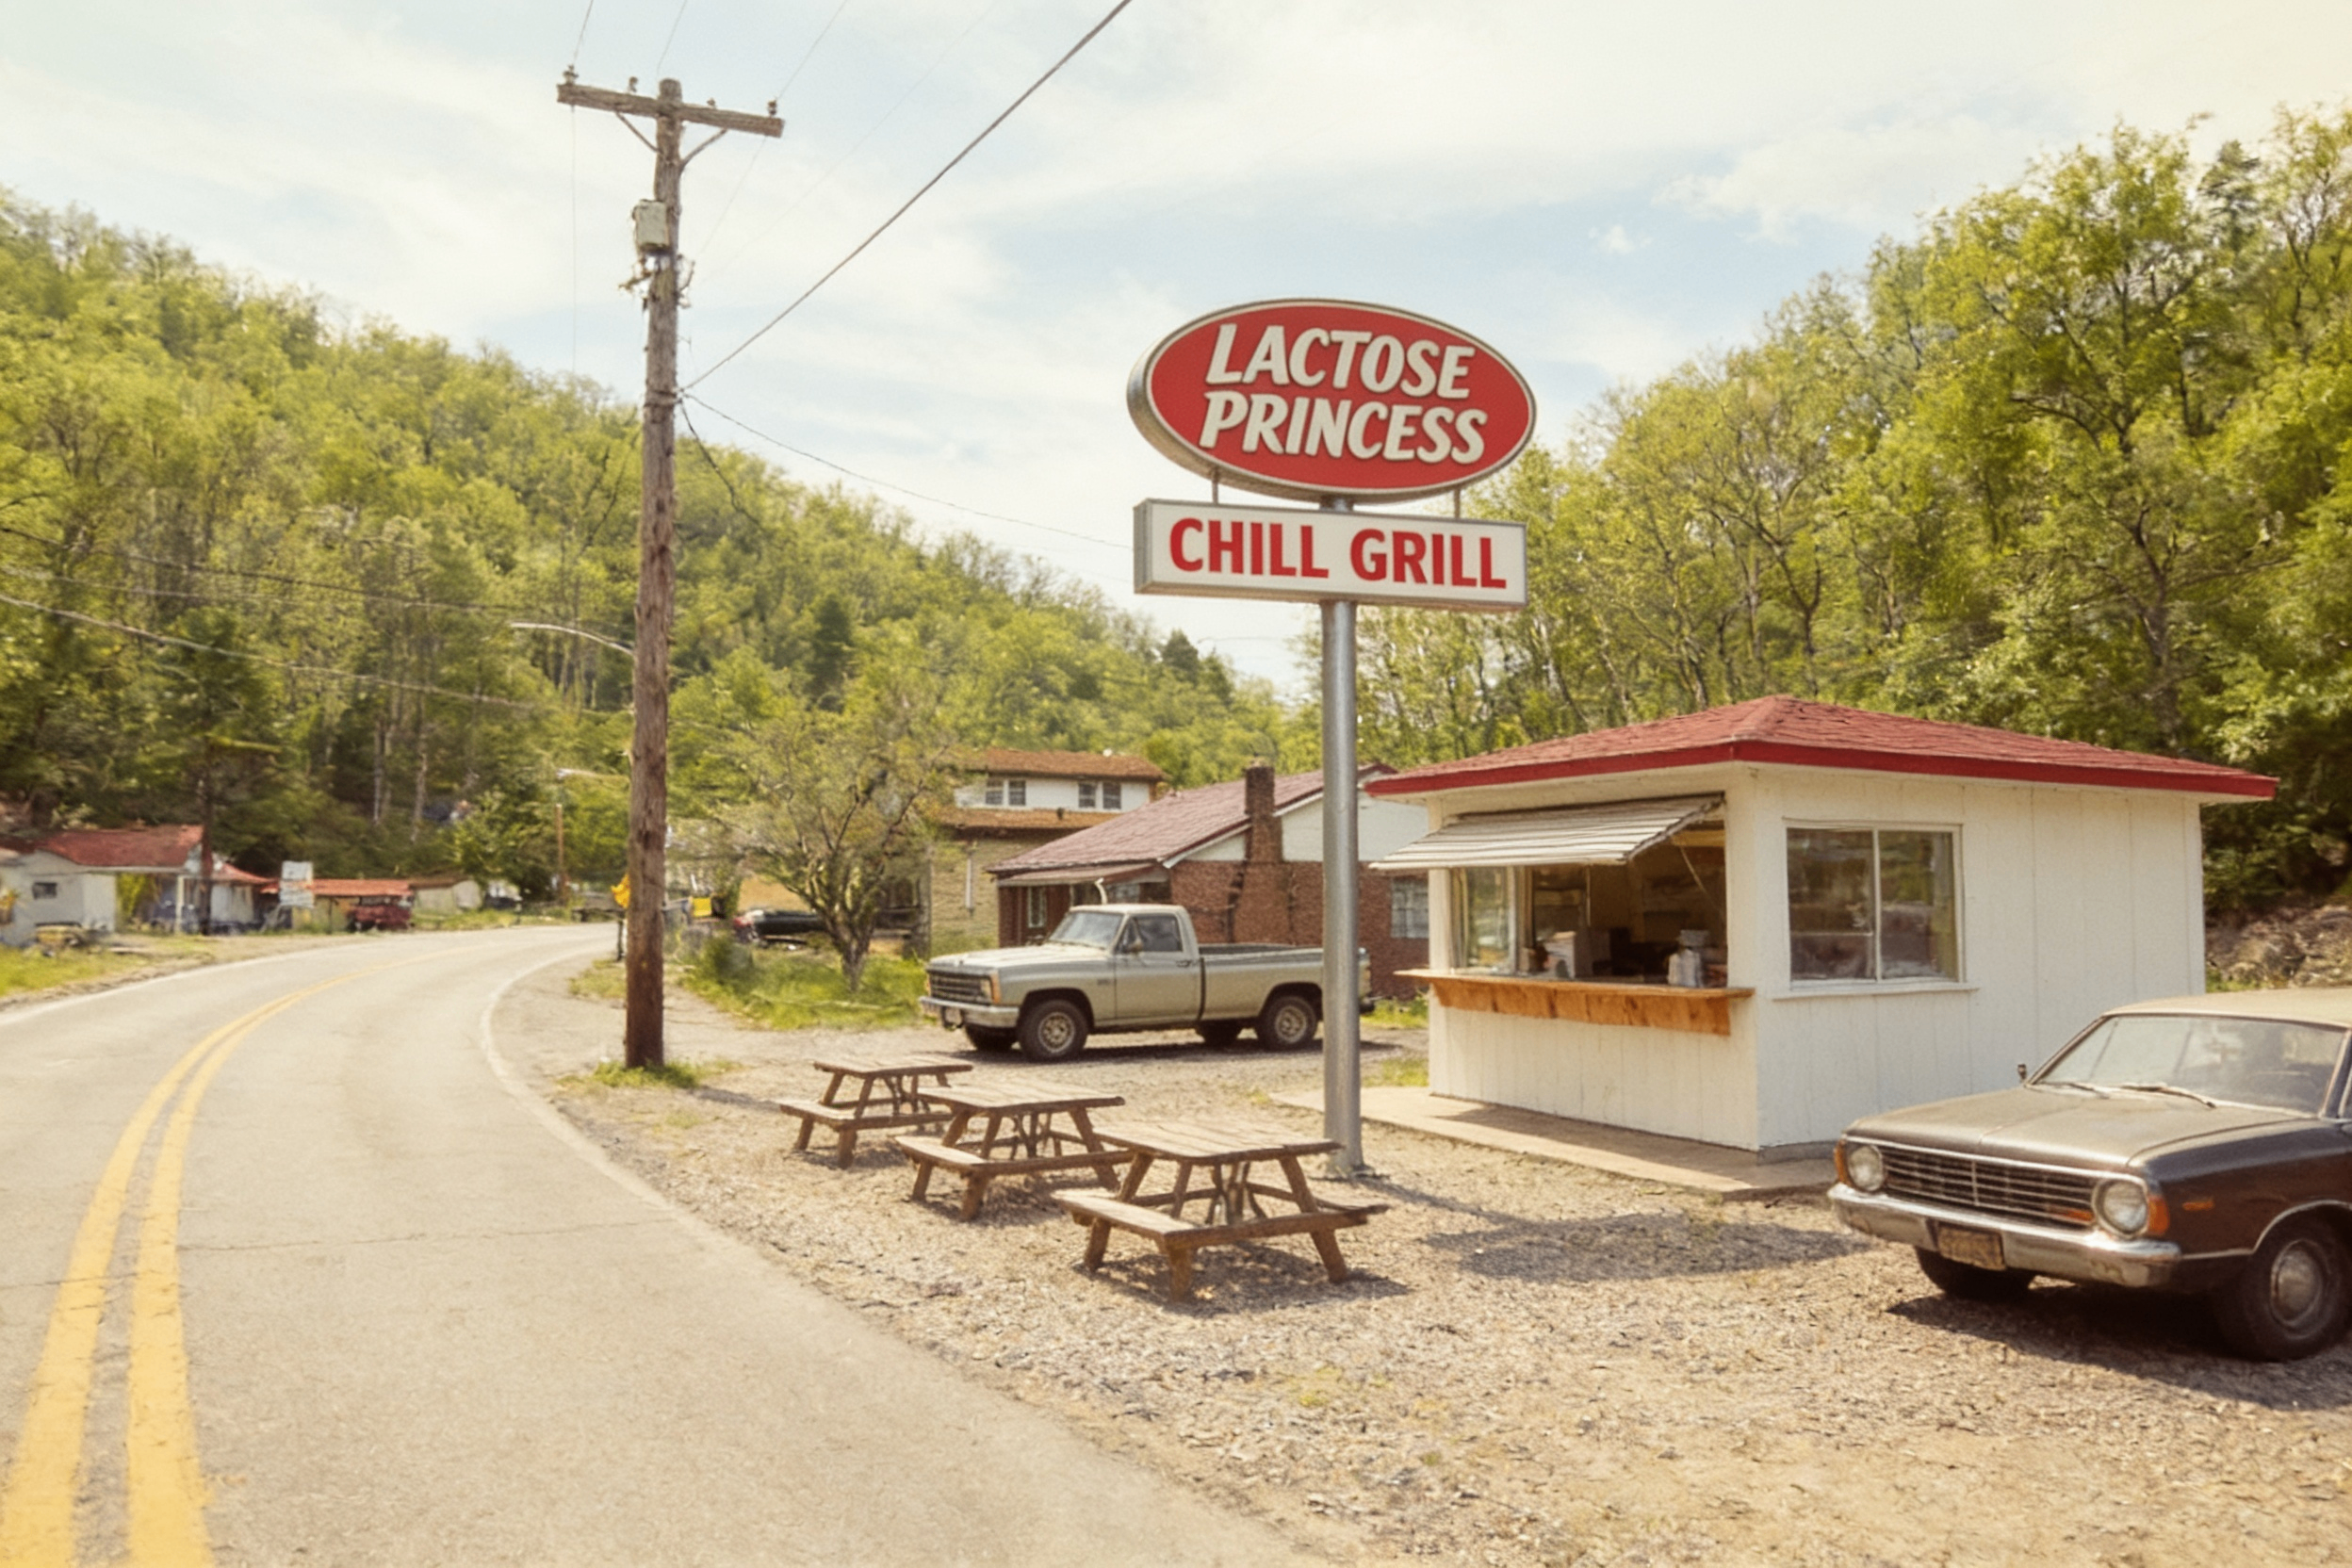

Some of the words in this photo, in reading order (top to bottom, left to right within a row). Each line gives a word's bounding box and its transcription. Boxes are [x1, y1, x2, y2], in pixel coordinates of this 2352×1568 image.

[1205, 323, 1475, 399] LACTOSE
[1199, 390, 1487, 464] PRINCESS
[1169, 517, 1329, 579] CHILL
[1349, 529, 1507, 589] GRILL
